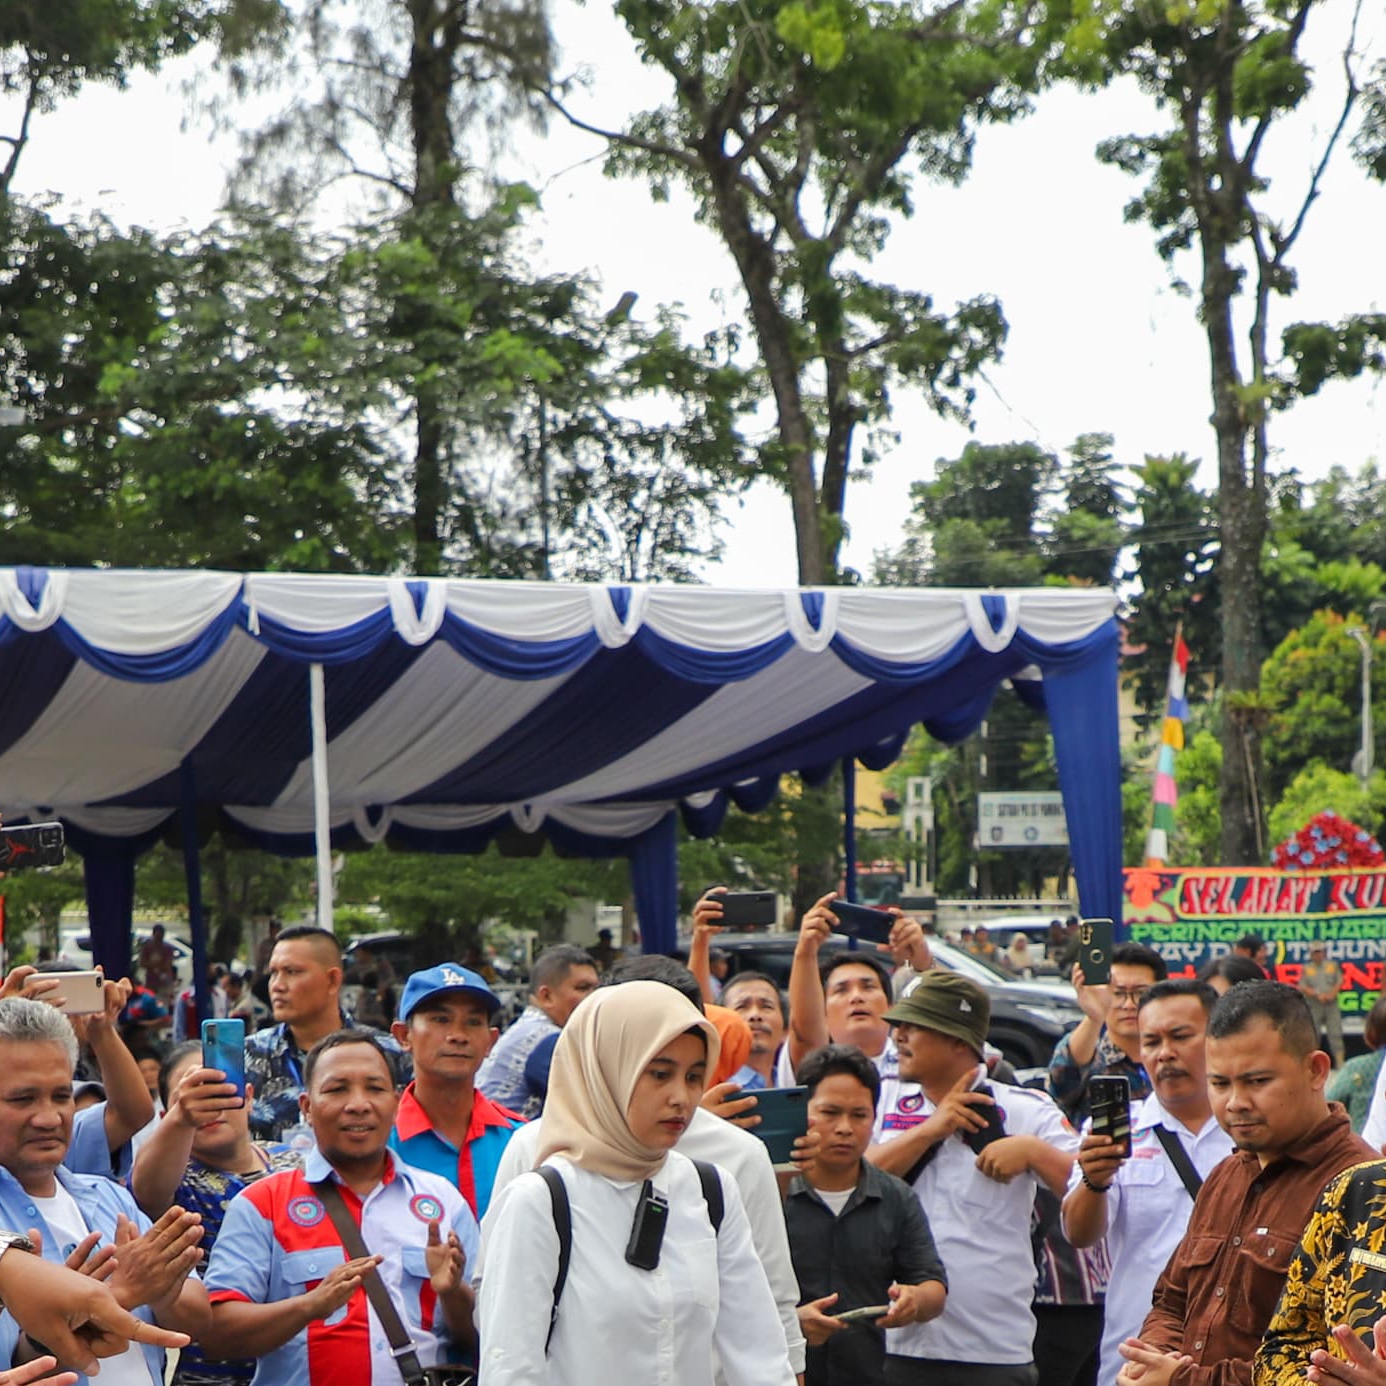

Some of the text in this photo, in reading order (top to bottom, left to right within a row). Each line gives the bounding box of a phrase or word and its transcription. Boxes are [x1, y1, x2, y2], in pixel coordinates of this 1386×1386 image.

[1181, 874, 1320, 914] SELAMAT
[1130, 922, 1318, 942] PERINGATAN
[440, 967, 464, 985] LA
